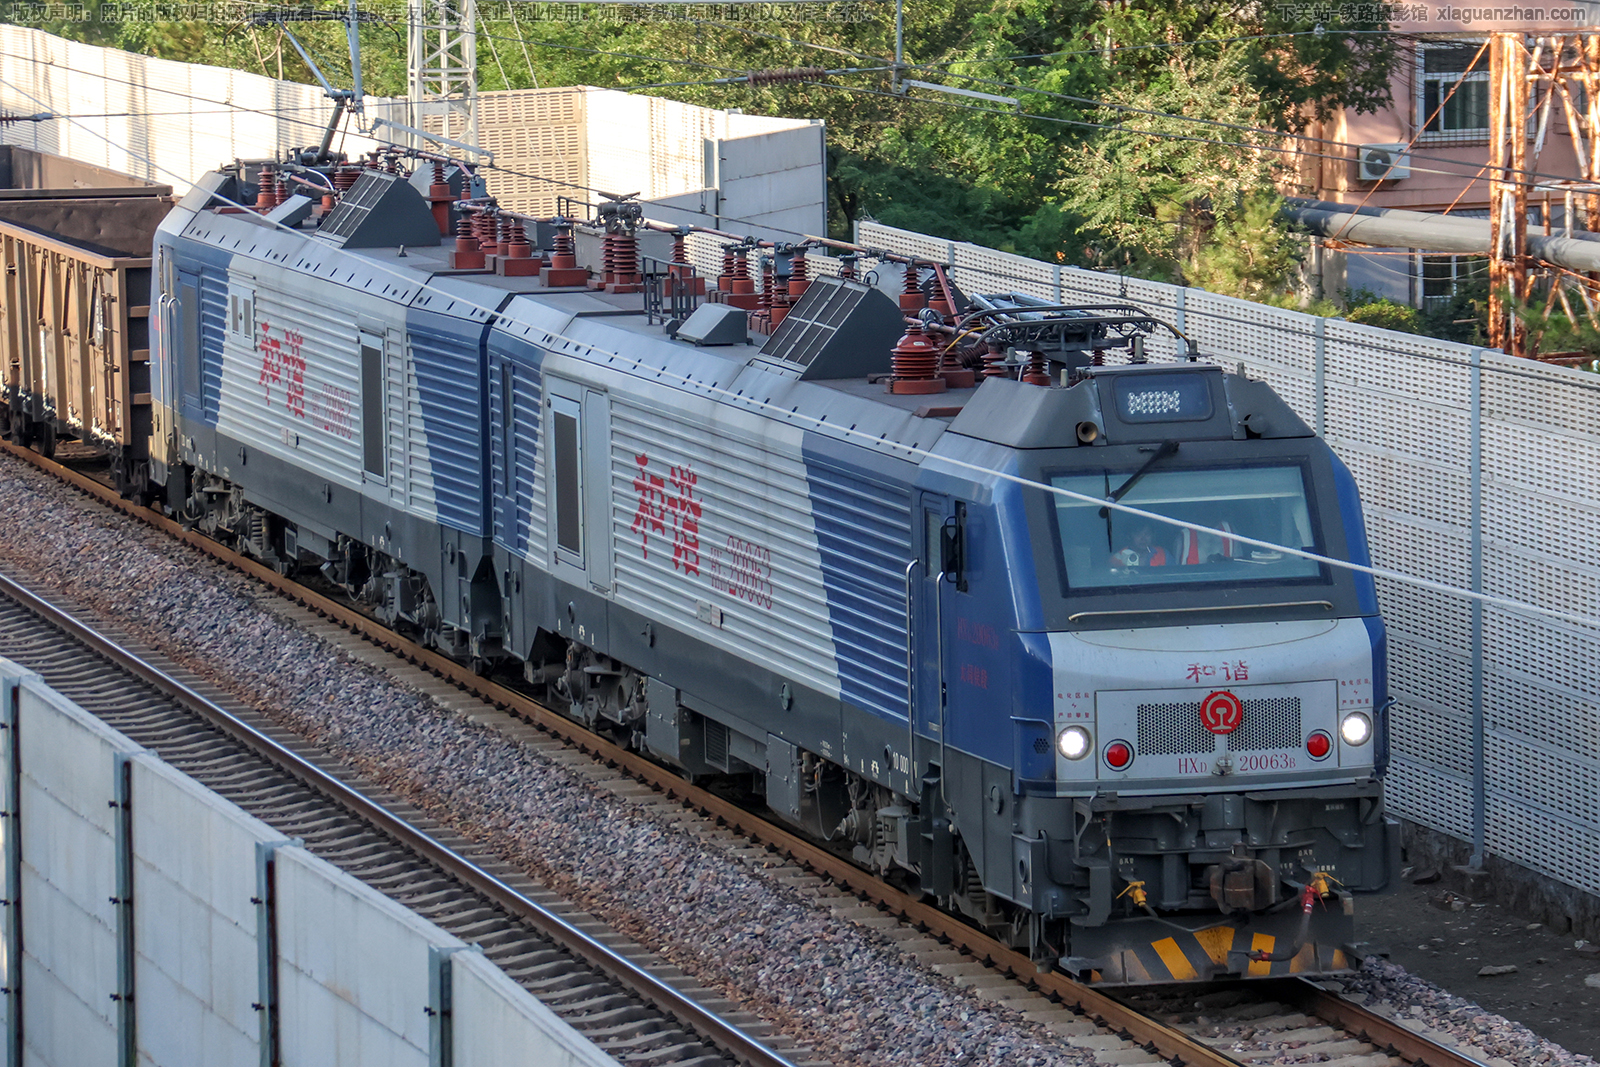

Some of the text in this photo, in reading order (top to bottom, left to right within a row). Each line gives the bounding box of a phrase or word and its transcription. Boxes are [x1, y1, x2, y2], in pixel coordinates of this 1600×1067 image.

[726, 535, 773, 610] 20063
[1185, 660, 1250, 683] 和谐
[1178, 753, 1297, 774] HXD 20063B
